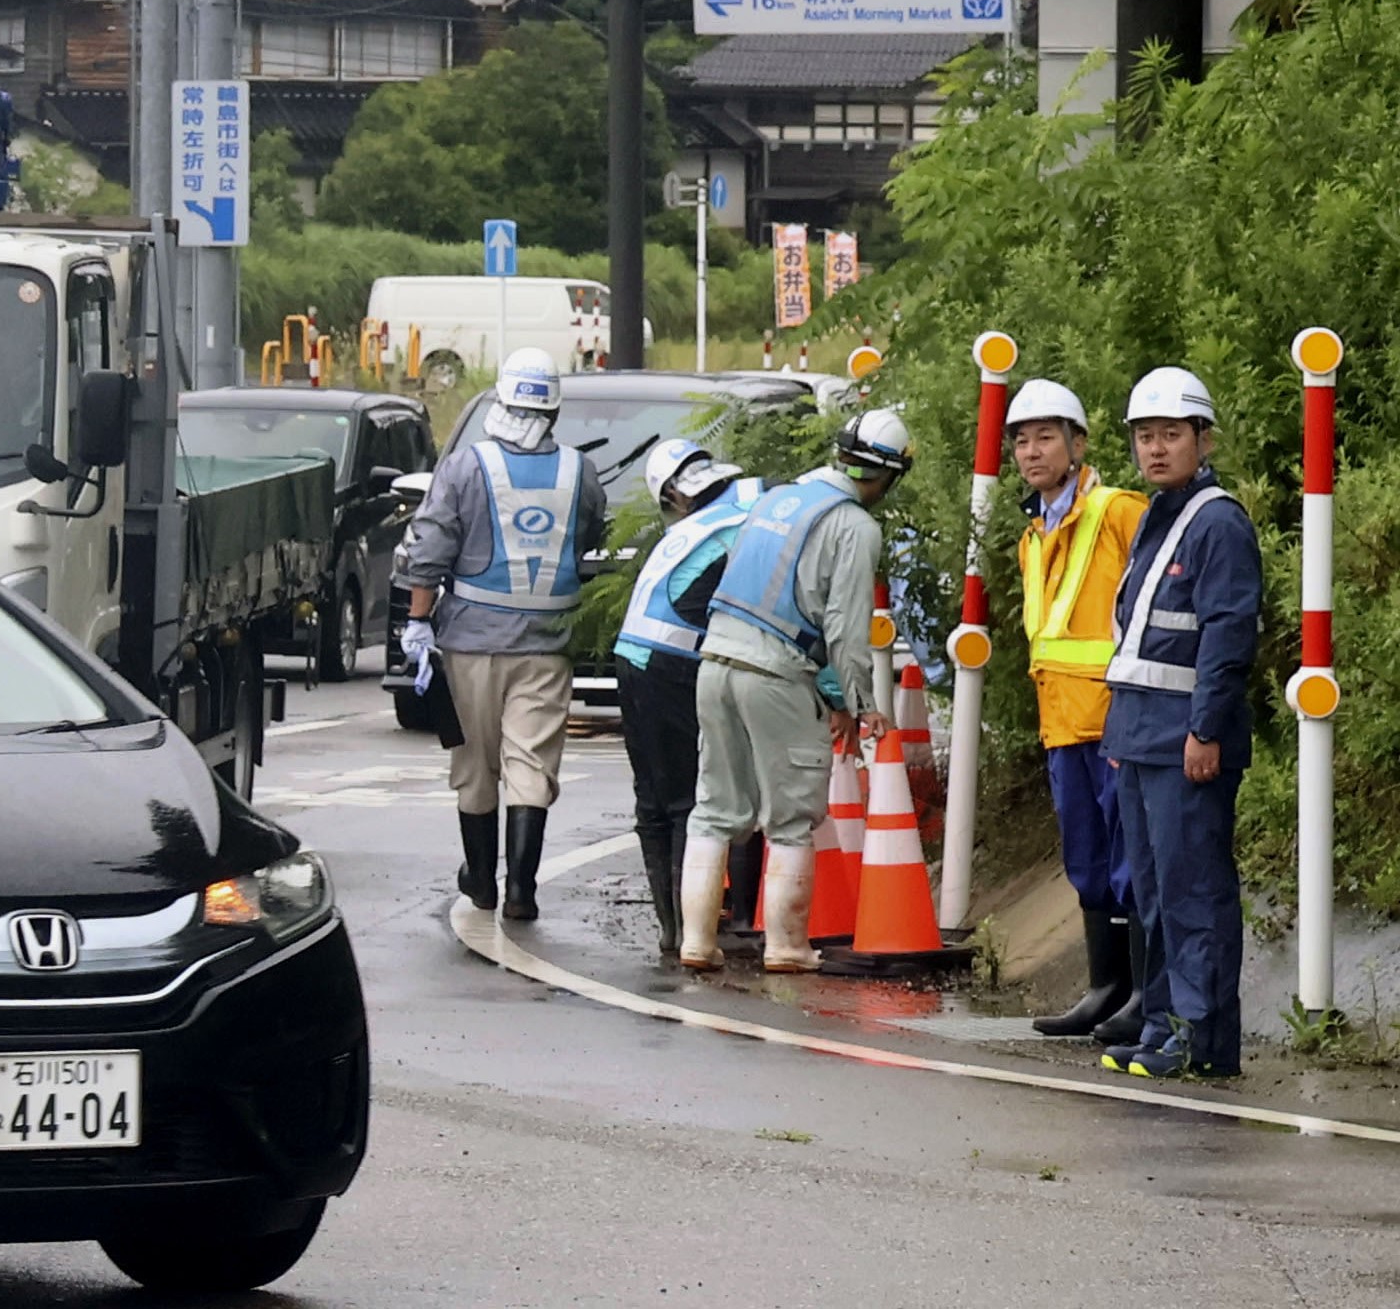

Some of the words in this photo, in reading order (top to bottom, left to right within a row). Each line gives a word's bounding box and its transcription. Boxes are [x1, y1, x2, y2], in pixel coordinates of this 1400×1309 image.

[854, 7, 904, 23] Morning
[909, 6, 953, 20] Market
[784, 245, 804, 318] お弁当
[10, 1091, 129, 1141] 44-04
